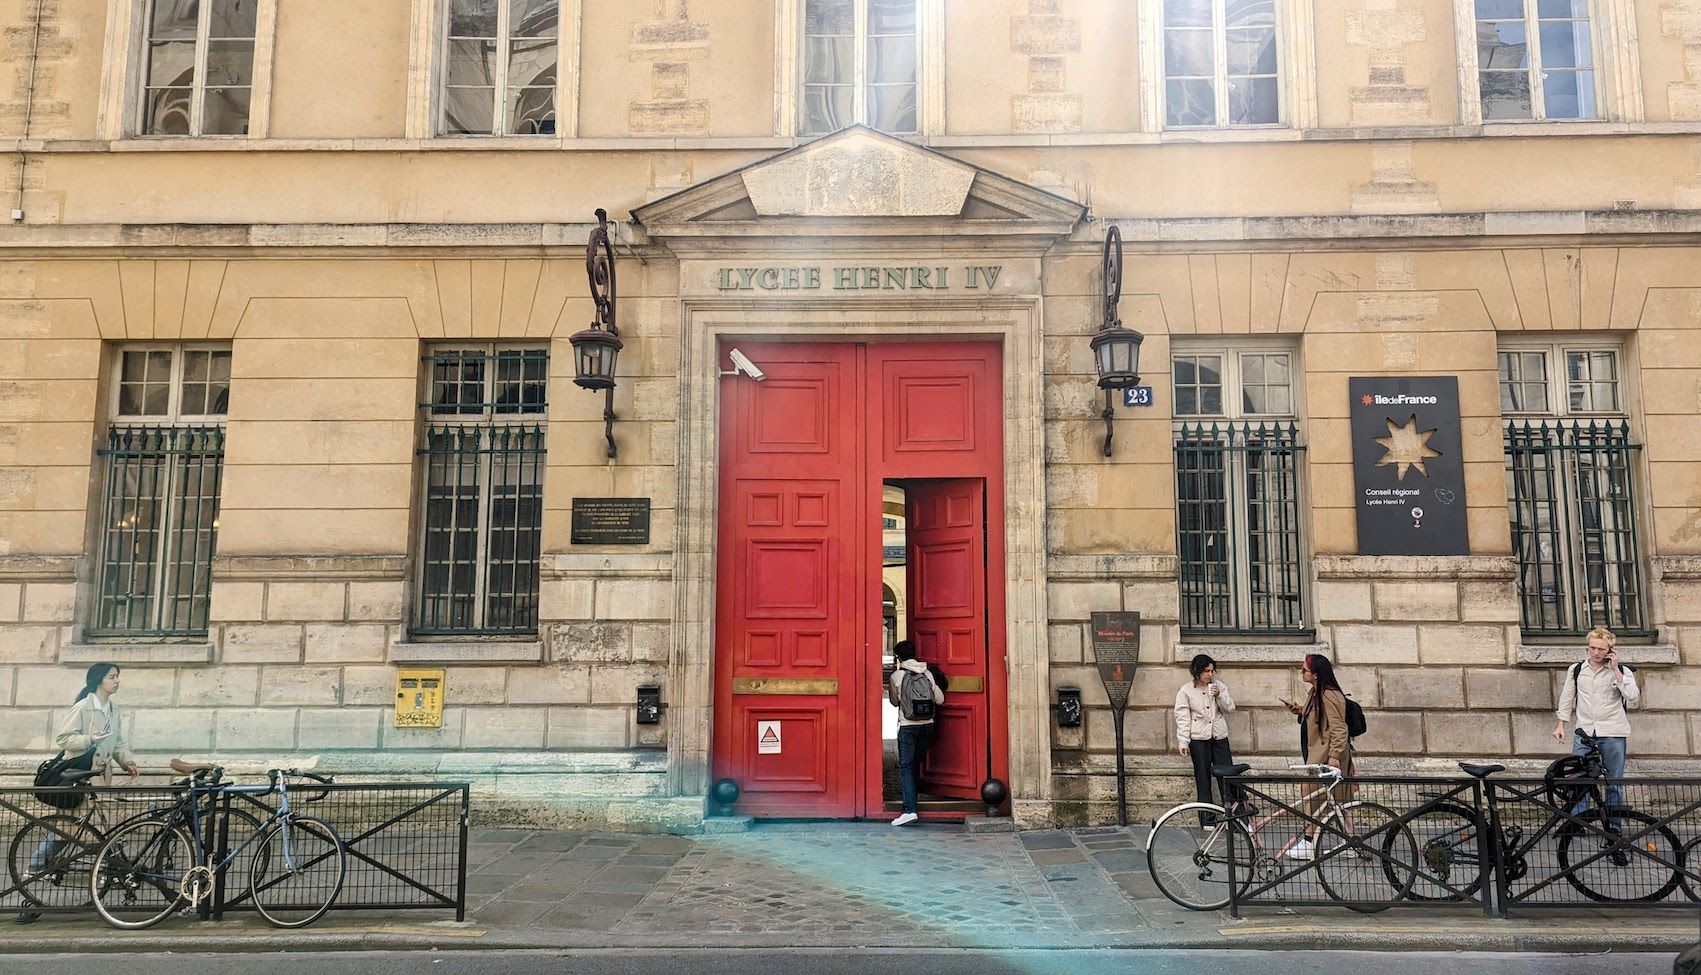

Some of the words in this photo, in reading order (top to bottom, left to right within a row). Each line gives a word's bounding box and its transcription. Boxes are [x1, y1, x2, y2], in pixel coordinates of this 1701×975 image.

[718, 266, 821, 290] LYCEE
[832, 266, 949, 290] HENRI
[965, 265, 1002, 290] IV
[1128, 388, 1148, 404] 23
[1365, 488, 1391, 496] Conseil
[1392, 488, 1420, 497] régional
